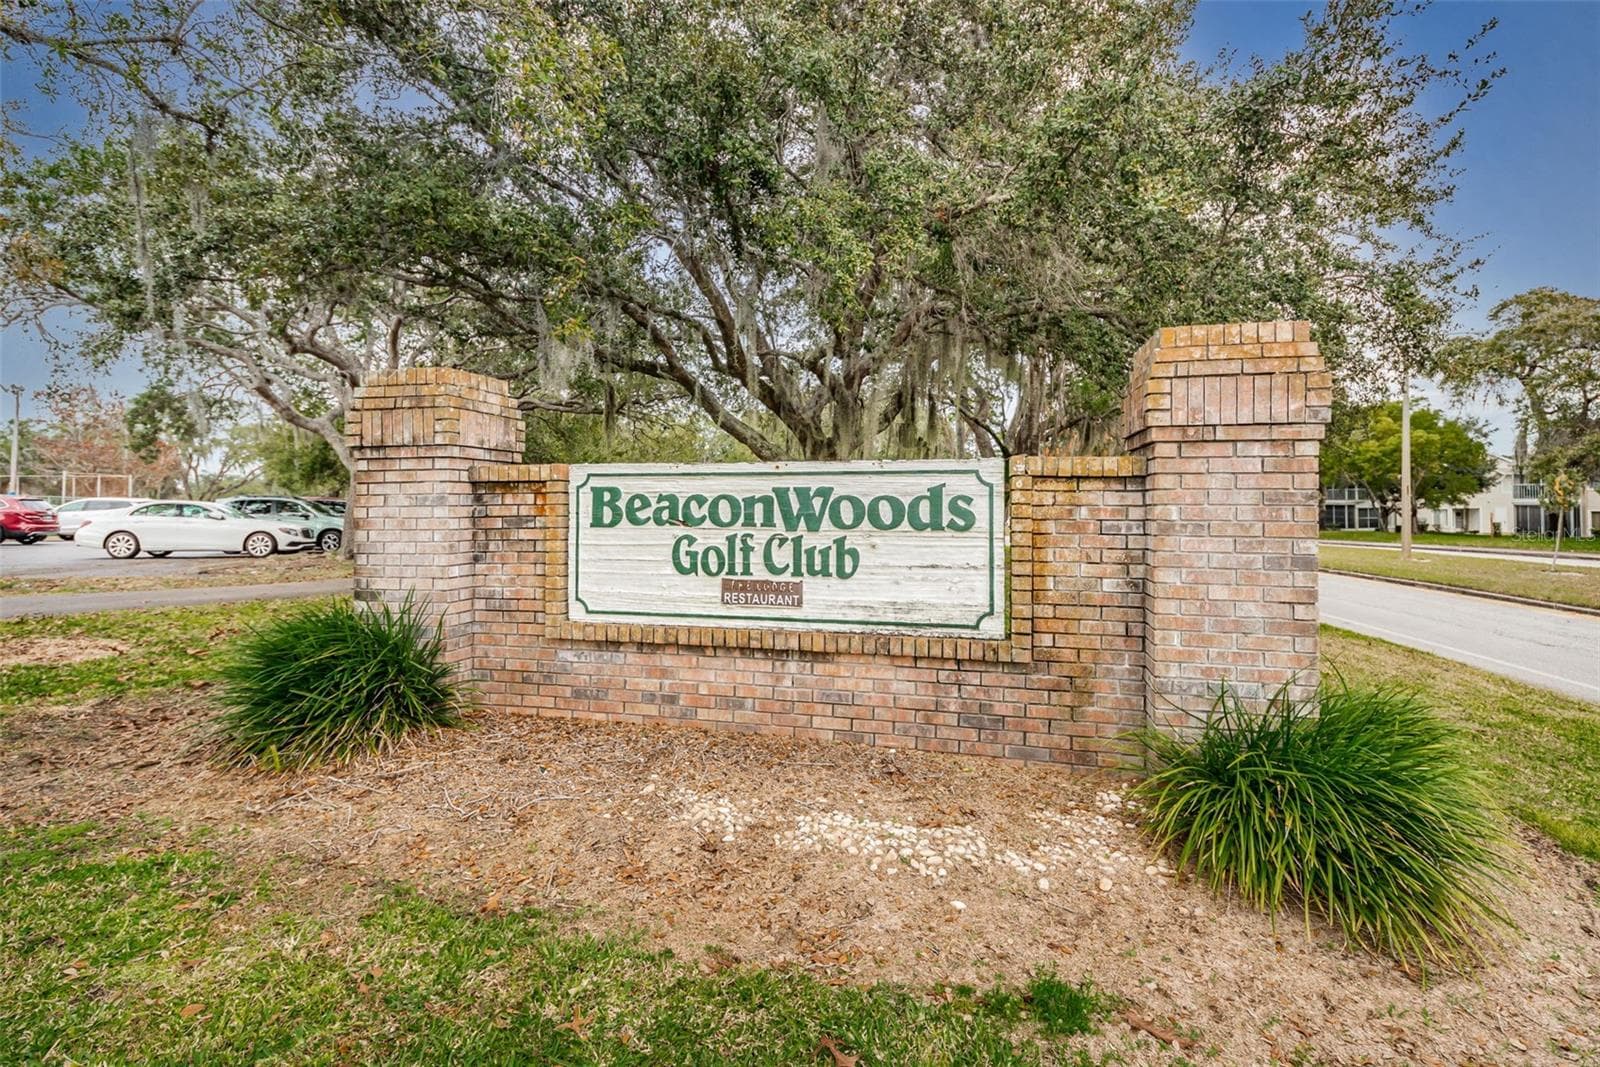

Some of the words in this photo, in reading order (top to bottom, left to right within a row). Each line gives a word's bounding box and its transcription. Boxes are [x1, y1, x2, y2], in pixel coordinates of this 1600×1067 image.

[672, 533, 755, 576] Golf
[763, 533, 860, 579] Club
[724, 592, 800, 605] RESTAURANT
